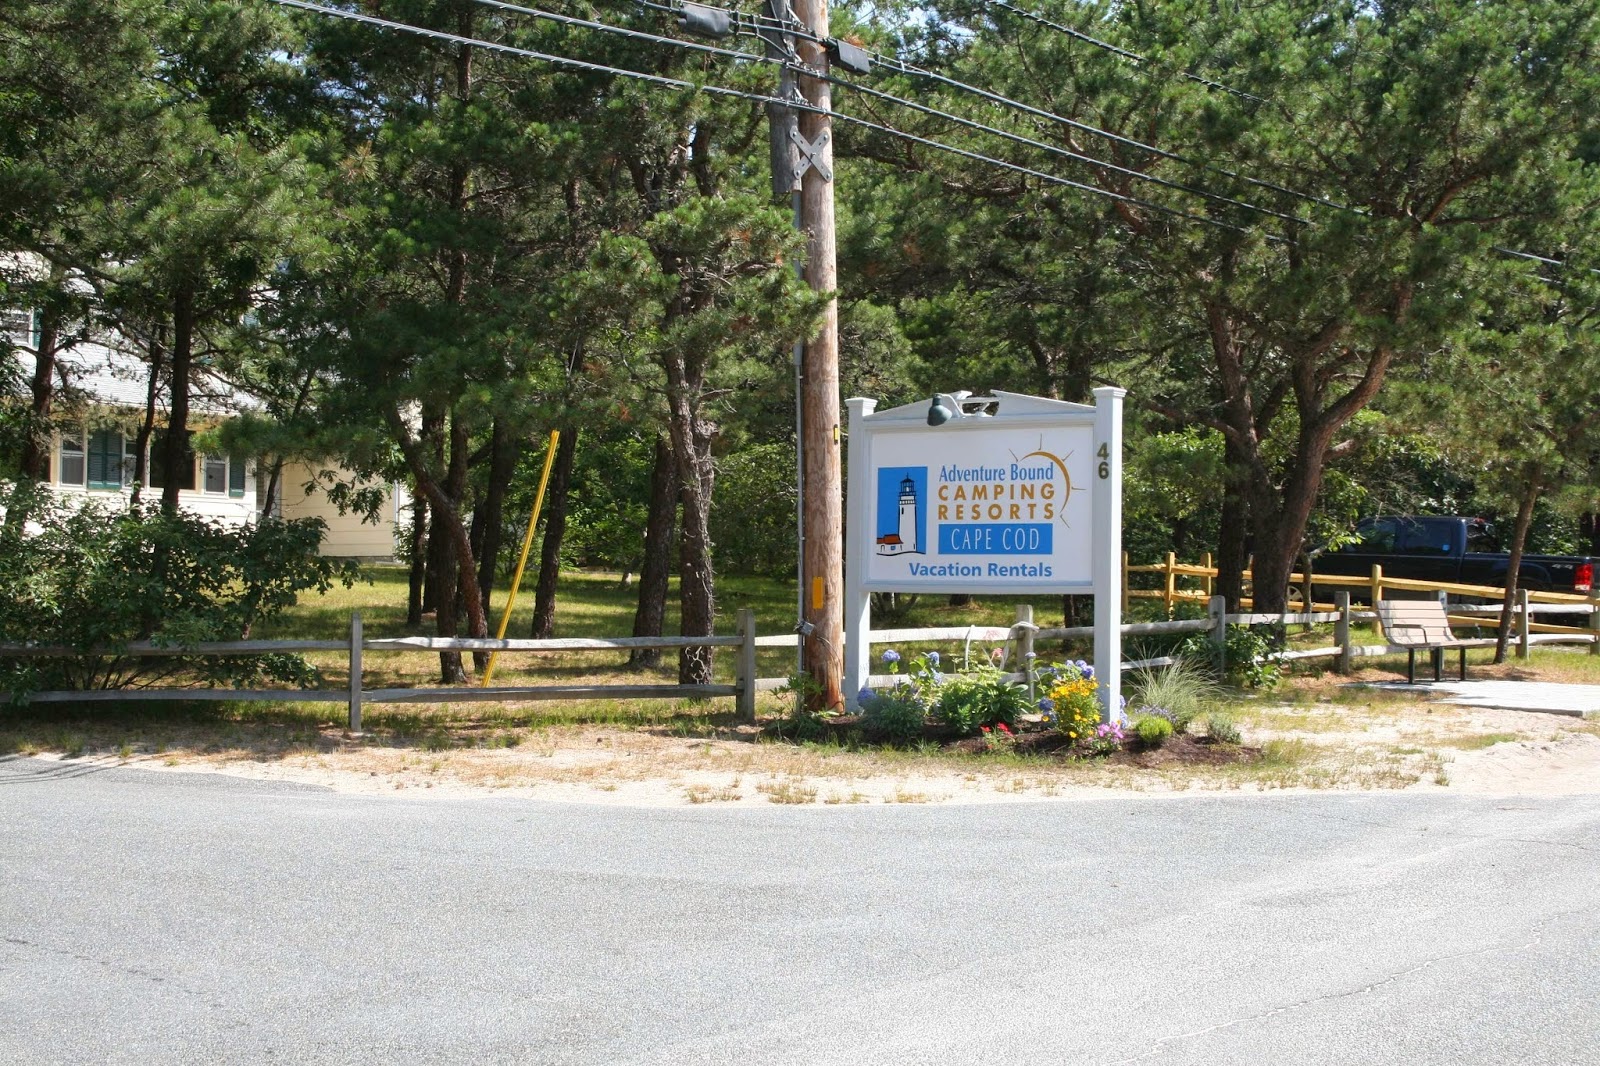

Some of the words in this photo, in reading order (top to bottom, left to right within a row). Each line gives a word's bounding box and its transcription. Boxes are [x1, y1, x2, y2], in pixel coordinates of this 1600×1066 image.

[1097, 442, 1109, 480] 46
[939, 465, 1006, 482] Adventure
[1010, 462, 1054, 481] Bound
[938, 483, 1055, 501] CAMPING
[938, 503, 1054, 520] RESORTS
[951, 528, 992, 550] CAPE
[1002, 528, 1040, 550] COD
[909, 563, 982, 577] Vacation
[988, 562, 1052, 577] Rentals
